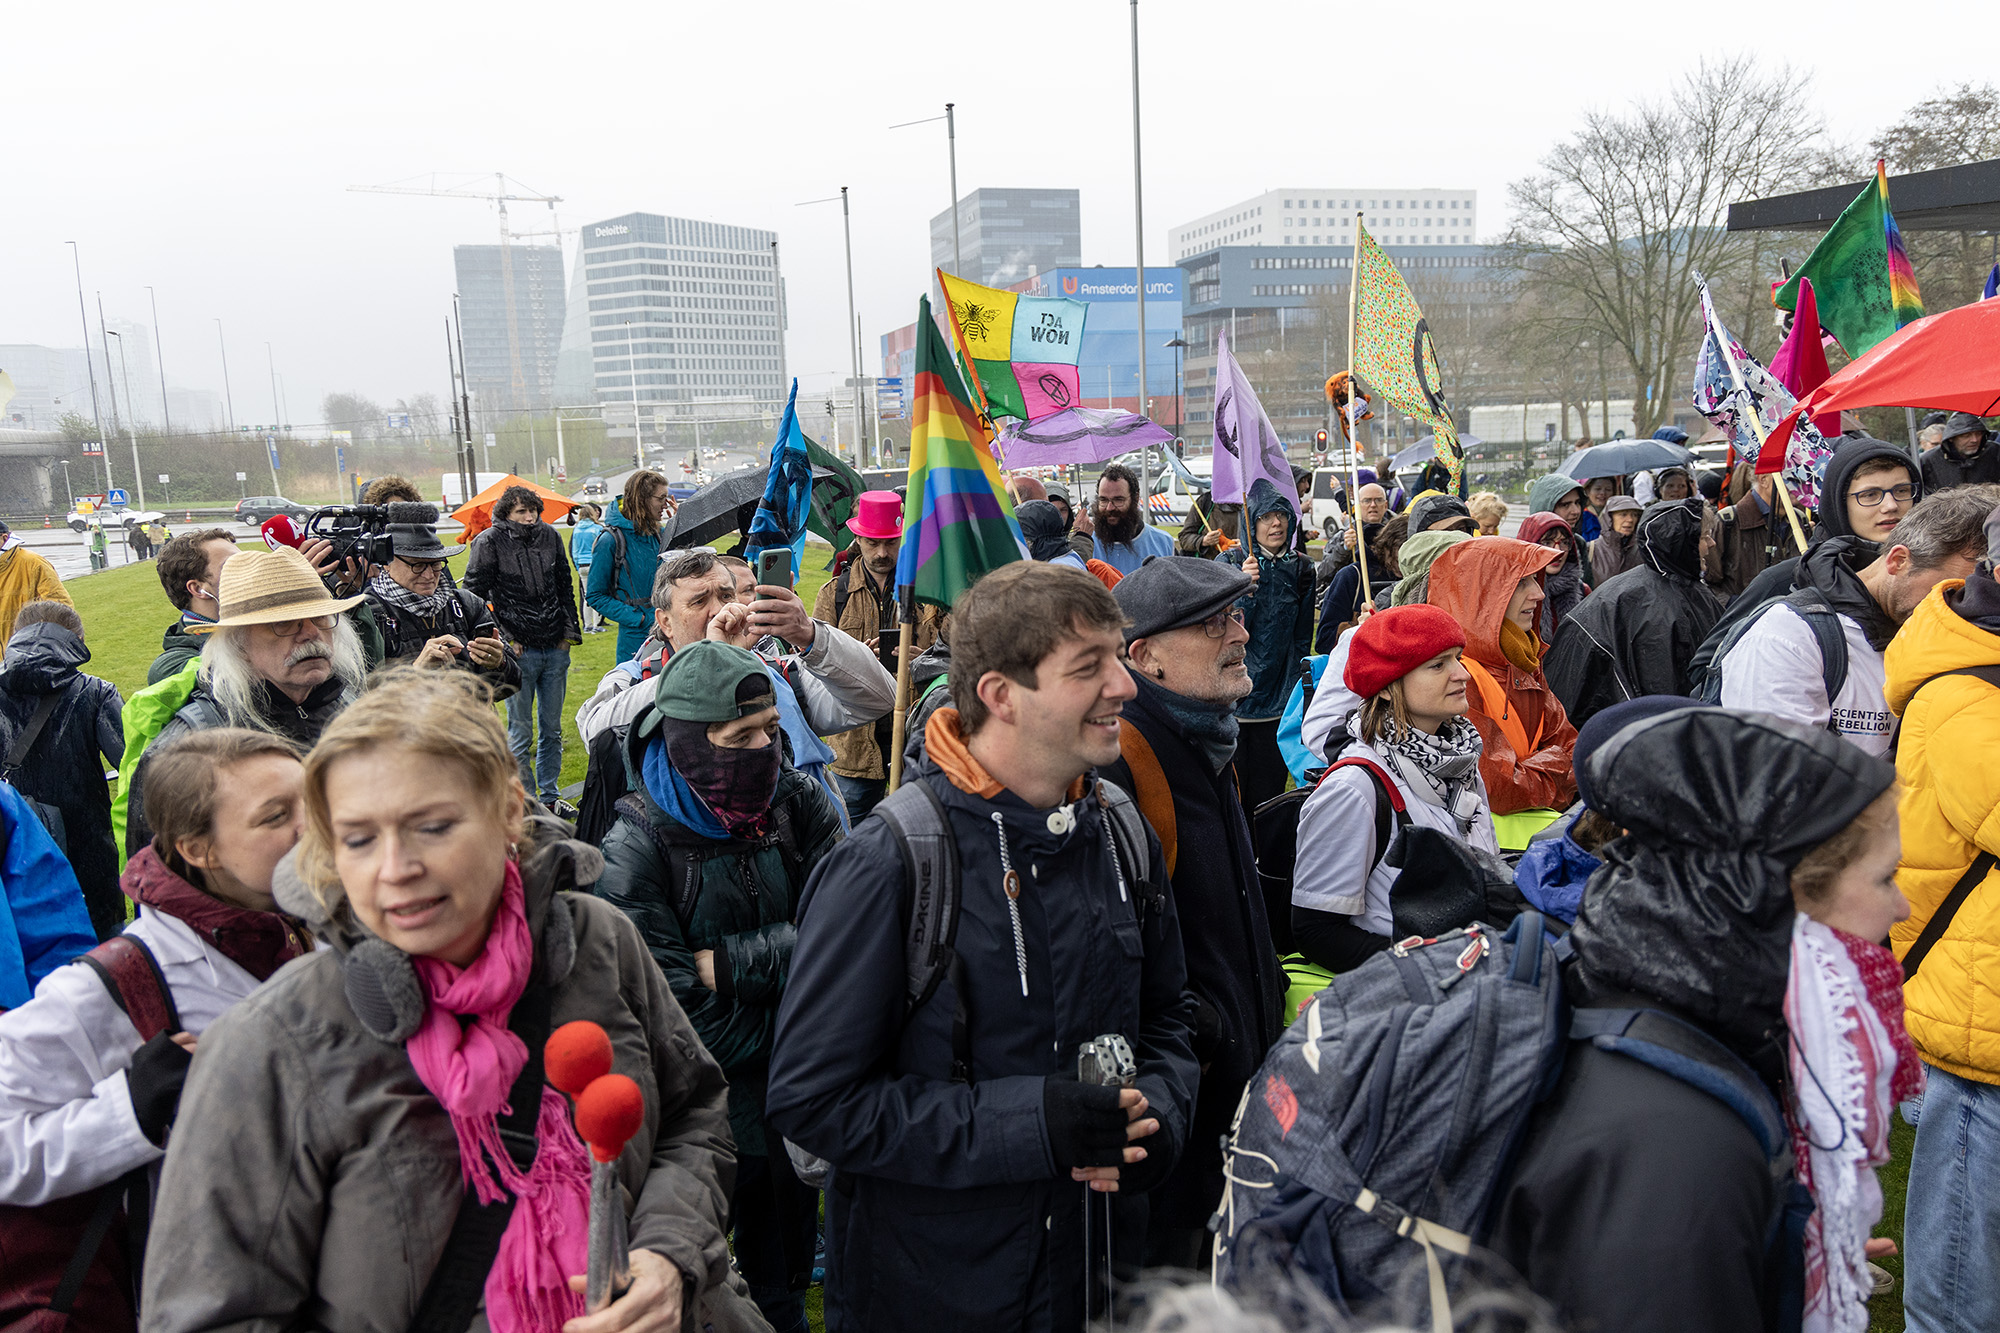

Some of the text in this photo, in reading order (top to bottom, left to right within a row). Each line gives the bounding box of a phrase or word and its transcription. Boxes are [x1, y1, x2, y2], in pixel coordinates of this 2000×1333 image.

[595, 224, 629, 238] Deloitte
[1146, 283, 1174, 294] UMC
[1832, 708, 1891, 721] SCIENTIST
[682, 866, 693, 901] GREGORY
[912, 857, 931, 945] DAKINE
